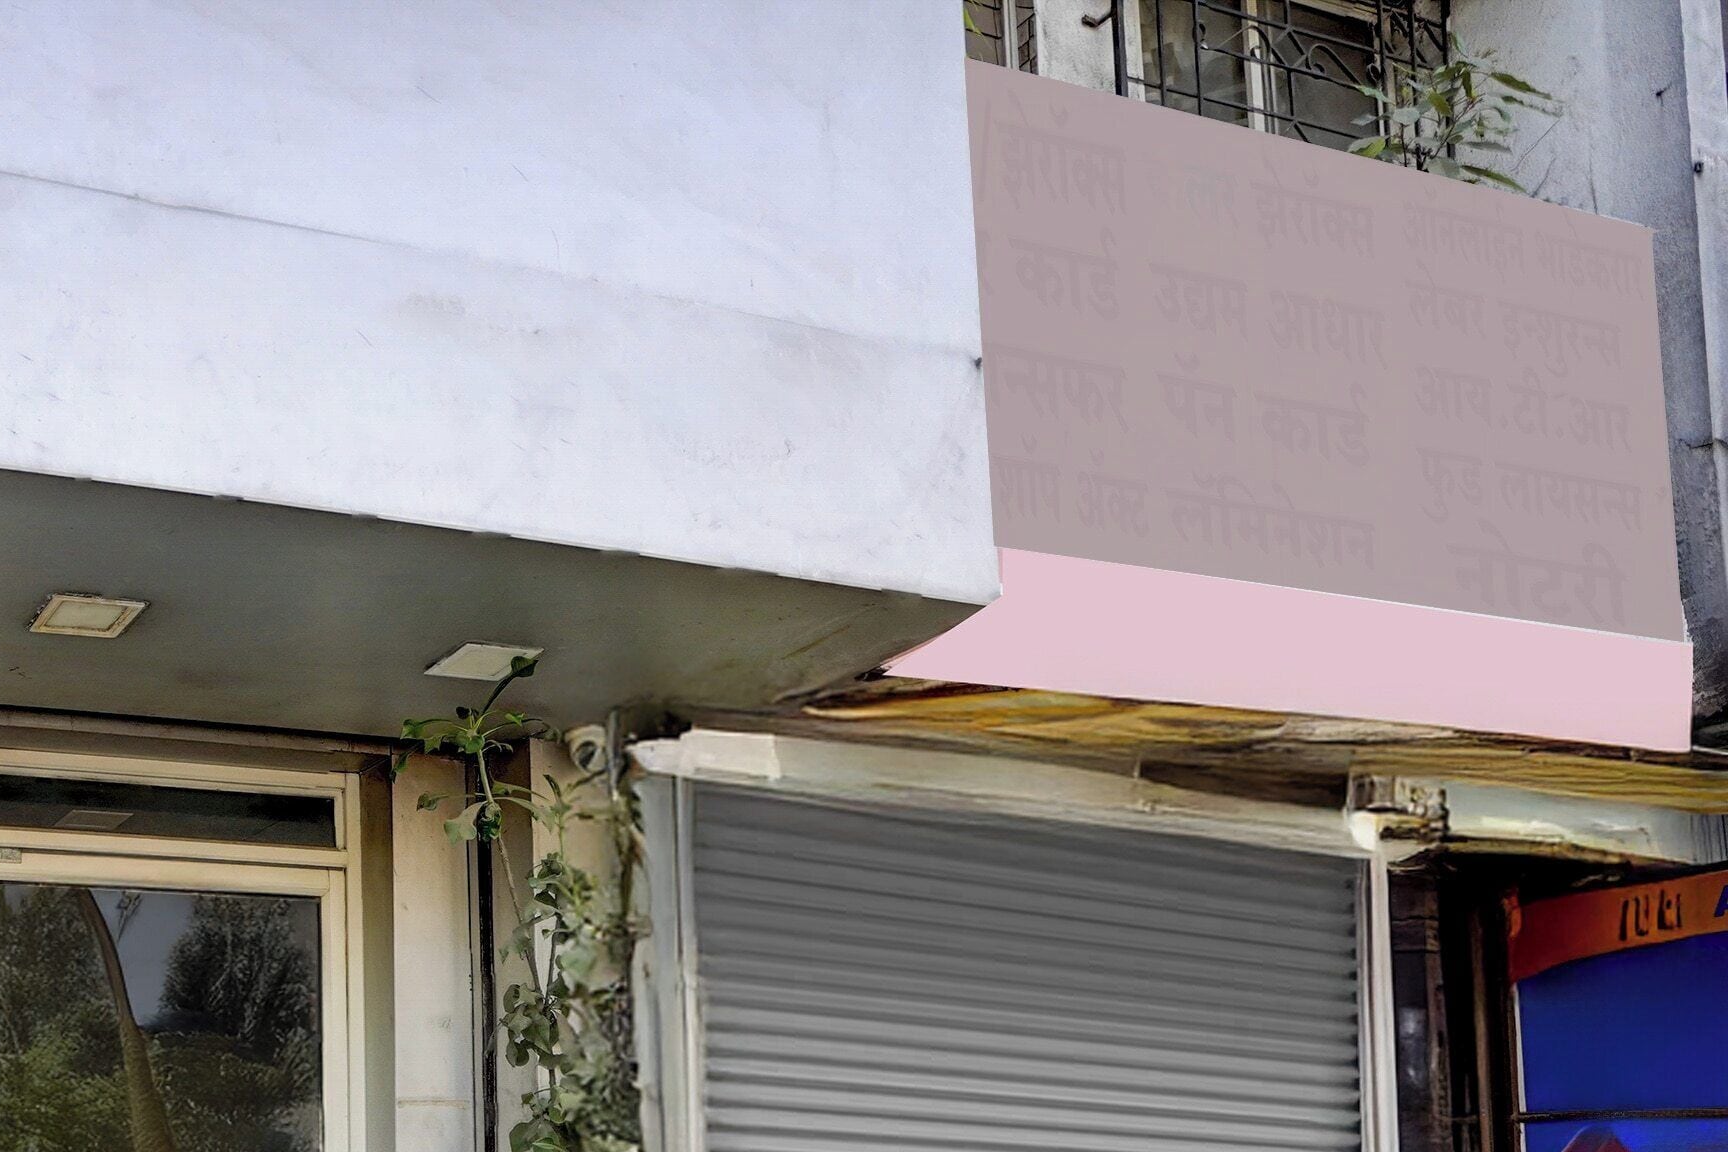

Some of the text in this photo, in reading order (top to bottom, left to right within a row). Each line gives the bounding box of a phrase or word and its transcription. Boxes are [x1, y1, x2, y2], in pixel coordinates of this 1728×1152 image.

[1007, 225, 1121, 321] कार्ड
[1265, 289, 1389, 370] आधार
[1254, 381, 1372, 468] कार्ड
[1445, 517, 1629, 627] नोटरी
